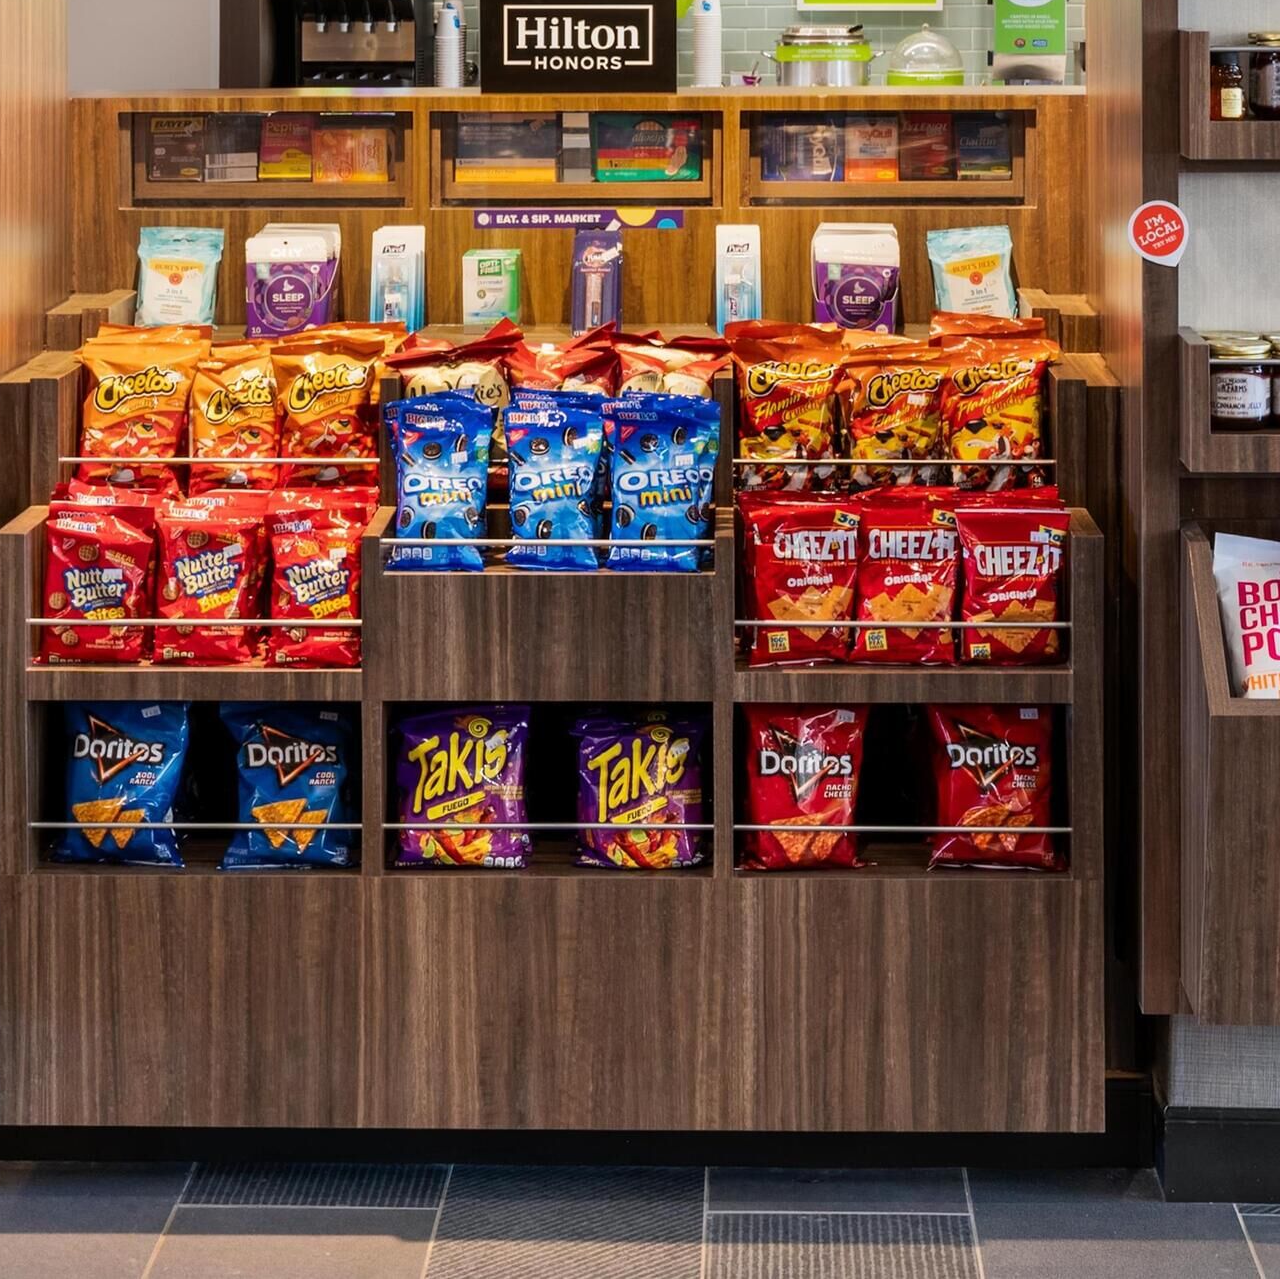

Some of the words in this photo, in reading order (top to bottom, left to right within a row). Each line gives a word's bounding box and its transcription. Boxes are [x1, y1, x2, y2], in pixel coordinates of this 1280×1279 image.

[516, 17, 641, 50] Hilton
[534, 56, 622, 70] HONORS
[496, 213, 519, 225] EAT.
[521, 213, 530, 224] &
[531, 213, 552, 224] SIP.
[554, 213, 601, 224] MARKET
[1144, 213, 1165, 230] I'M
[1138, 220, 1181, 246] LOCAL
[1152, 240, 1165, 249] TRY
[272, 293, 304, 302] SLEEP
[842, 295, 875, 304] SLEEP
[251, 326, 261, 334] 10
[96, 365, 176, 412] Cheetos
[750, 361, 834, 396] Cheetos
[805, 380, 830, 398] Hot
[868, 370, 941, 409] Cheetos
[404, 474, 482, 492] OREO
[516, 467, 593, 491] OREO
[620, 469, 700, 491] OREO
[532, 482, 582, 502] mini
[639, 488, 692, 507] mini
[176, 553, 229, 578] Nutter
[287, 560, 343, 587] Nutter
[185, 564, 240, 593] Butter
[296, 568, 350, 602] Butter
[73, 584, 126, 606] Butter
[196, 589, 238, 613] Bites
[85, 606, 125, 620] Bites
[311, 596, 351, 619] Bites
[73, 734, 164, 764] Doritos
[248, 742, 337, 767] Doritos
[946, 743, 1037, 768] Doritos
[408, 729, 510, 814] Takis
[760, 750, 852, 775] Doritos
[129, 778, 156, 786] RANCH
[309, 778, 336, 786] RANCH
[316, 771, 336, 779] COOL
[588, 738, 690, 823] Takis
[1011, 780, 1037, 789] CHEESE
[823, 790, 852, 799] CHEESE
[441, 798, 469, 814] FUEGO
[627, 804, 653, 821] FUEGO
